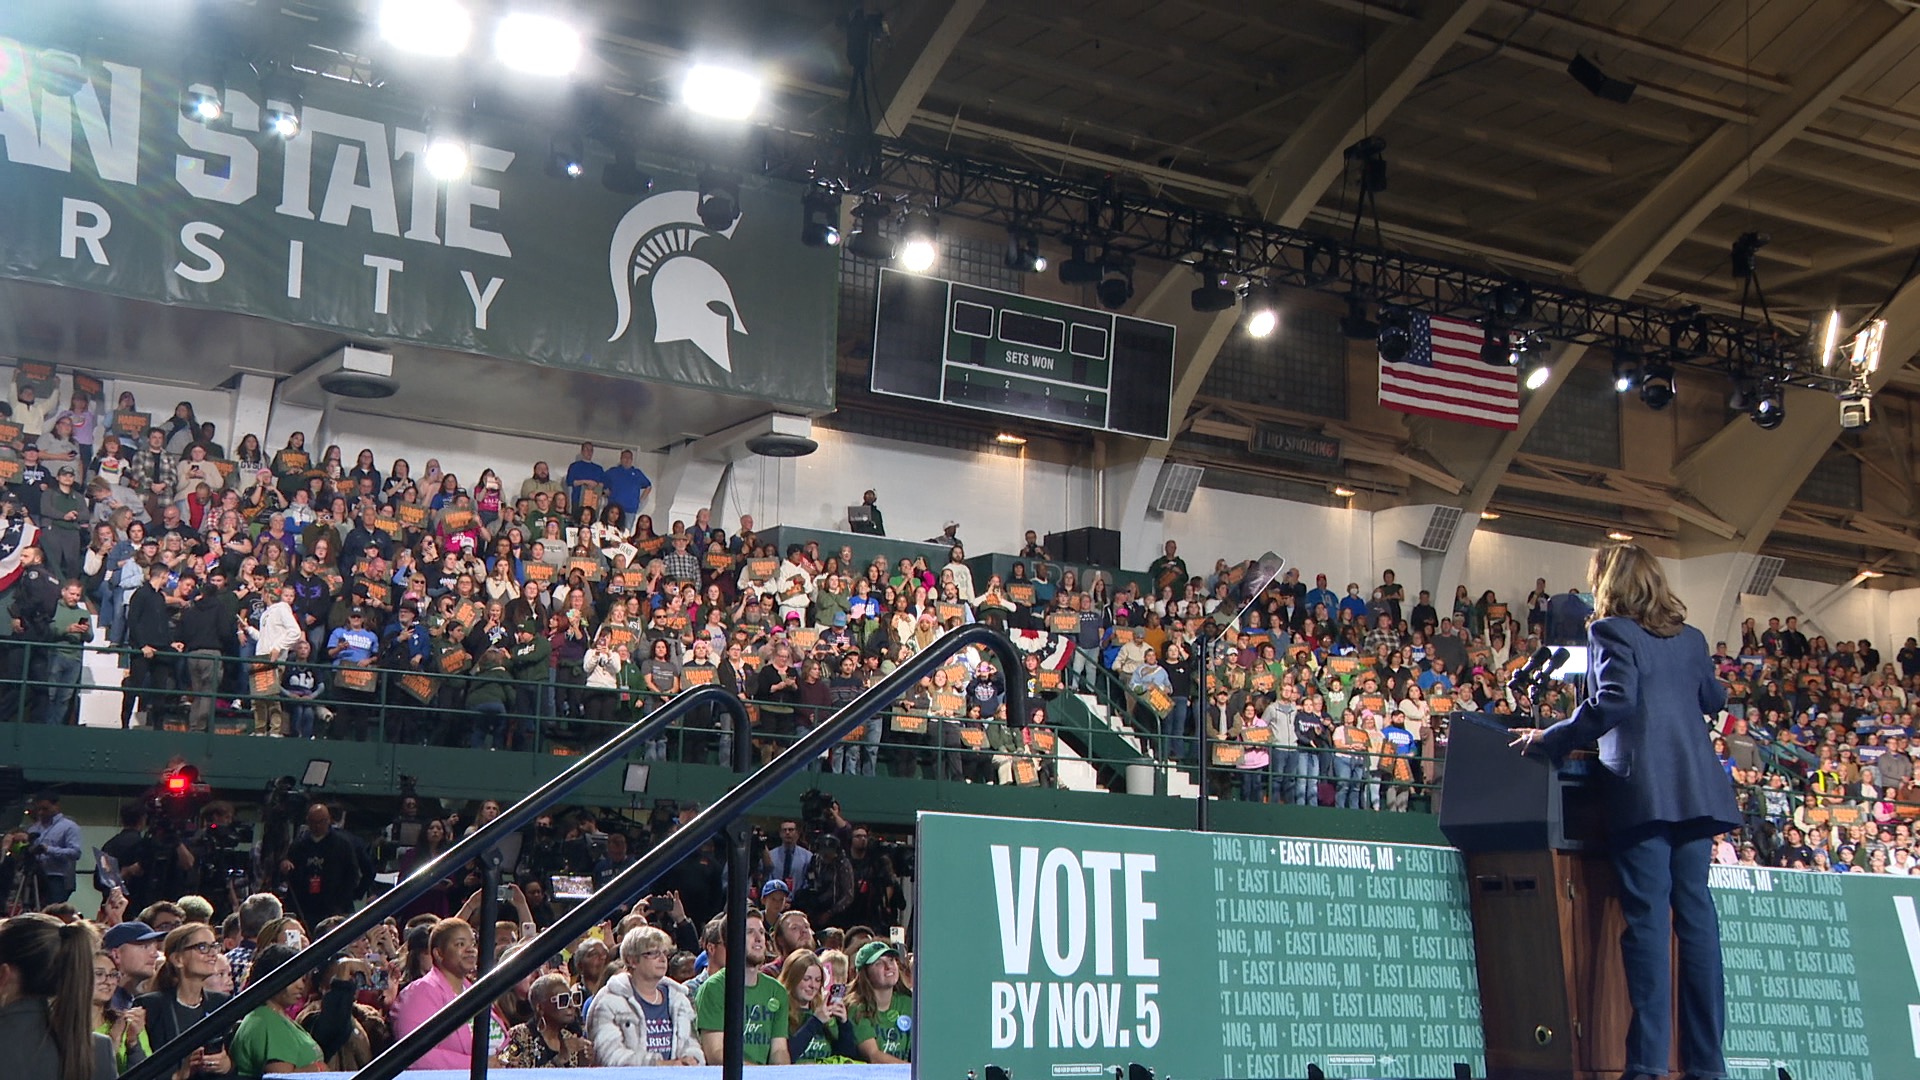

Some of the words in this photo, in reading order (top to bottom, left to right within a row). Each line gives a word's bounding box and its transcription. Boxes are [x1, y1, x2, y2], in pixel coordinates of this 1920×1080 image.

[176, 82, 515, 257] STATE
[1005, 350, 1029, 365] SETS
[1031, 354, 1054, 371] WON
[964, 373, 968, 381] 1
[1005, 380, 1010, 389] 2
[1045, 387, 1050, 396] 3
[1085, 394, 1090, 402] 4
[1249, 839, 1268, 863] MI
[1279, 840, 1312, 866] EAST
[1313, 843, 1376, 873] LANSING,
[1376, 846, 1394, 871] MI
[1404, 849, 1434, 873] EAST
[1237, 868, 1270, 894] EAST
[1272, 870, 1335, 900] LANSING,
[1337, 874, 1354, 898] MI
[1366, 875, 1396, 899] EAST
[1399, 878, 1457, 906] LANSING,
[1754, 870, 1773, 892] MI
[1781, 872, 1809, 893] EAST
[1810, 874, 1843, 896] LANS
[990, 844, 1160, 977] VOTE
[1229, 898, 1294, 928] LANSING,
[1296, 901, 1315, 926] MI
[1326, 903, 1358, 928] EAST
[1360, 904, 1420, 933] LANSING,
[1422, 906, 1439, 930] MI
[1722, 894, 1739, 916] MI
[1748, 896, 1777, 917] EAST
[1778, 898, 1833, 923] LANSING,
[1254, 930, 1273, 954] MI
[1285, 931, 1317, 956] EAST
[1320, 932, 1381, 961] LANSING,
[1383, 935, 1400, 958] MI
[1411, 936, 1442, 959] EAST
[1444, 937, 1475, 961] LANS
[1745, 922, 1800, 948] LANSING,
[1801, 925, 1818, 946] MI
[1826, 926, 1850, 948] EAS
[1242, 960, 1275, 985] EAST
[1278, 961, 1341, 990] LANSING,
[1343, 963, 1361, 987] MI
[1373, 964, 1403, 988] EAST
[1406, 965, 1464, 992] LANSING,
[1769, 949, 1786, 971] MI
[1794, 950, 1822, 972] EAST
[1824, 952, 1856, 975] LANS
[1734, 974, 1752, 997] MI
[1760, 975, 1788, 998] EAST
[1791, 977, 1847, 1004] LANSING,
[991, 981, 1042, 1049] BY
[1048, 981, 1130, 1049] NOV.
[1136, 984, 1161, 1049] 5
[1234, 991, 1300, 1020] LANSING,
[1302, 992, 1320, 1017] MI
[1332, 993, 1364, 1017] EAST
[1367, 993, 1428, 1021] LANSING,
[1429, 995, 1447, 1018] MI
[1457, 996, 1481, 1019] EAS
[1727, 1002, 1755, 1024] EAST
[1757, 1003, 1815, 1029] LANSING,
[1814, 1005, 1832, 1027] MI
[1840, 1006, 1864, 1028] EAS
[805, 1036, 827, 1053] for
[1259, 1022, 1278, 1048] MI
[1290, 1023, 1322, 1048] EAST
[1325, 1023, 1388, 1051] LANSING,
[1390, 1024, 1408, 1048] MI
[1419, 1024, 1449, 1049] EAST
[1451, 1025, 1484, 1049] LANS
[1780, 1031, 1799, 1054] MI
[1806, 1032, 1836, 1055] EAST
[1838, 1033, 1870, 1056] LANS
[1246, 1054, 1280, 1079] EAST
